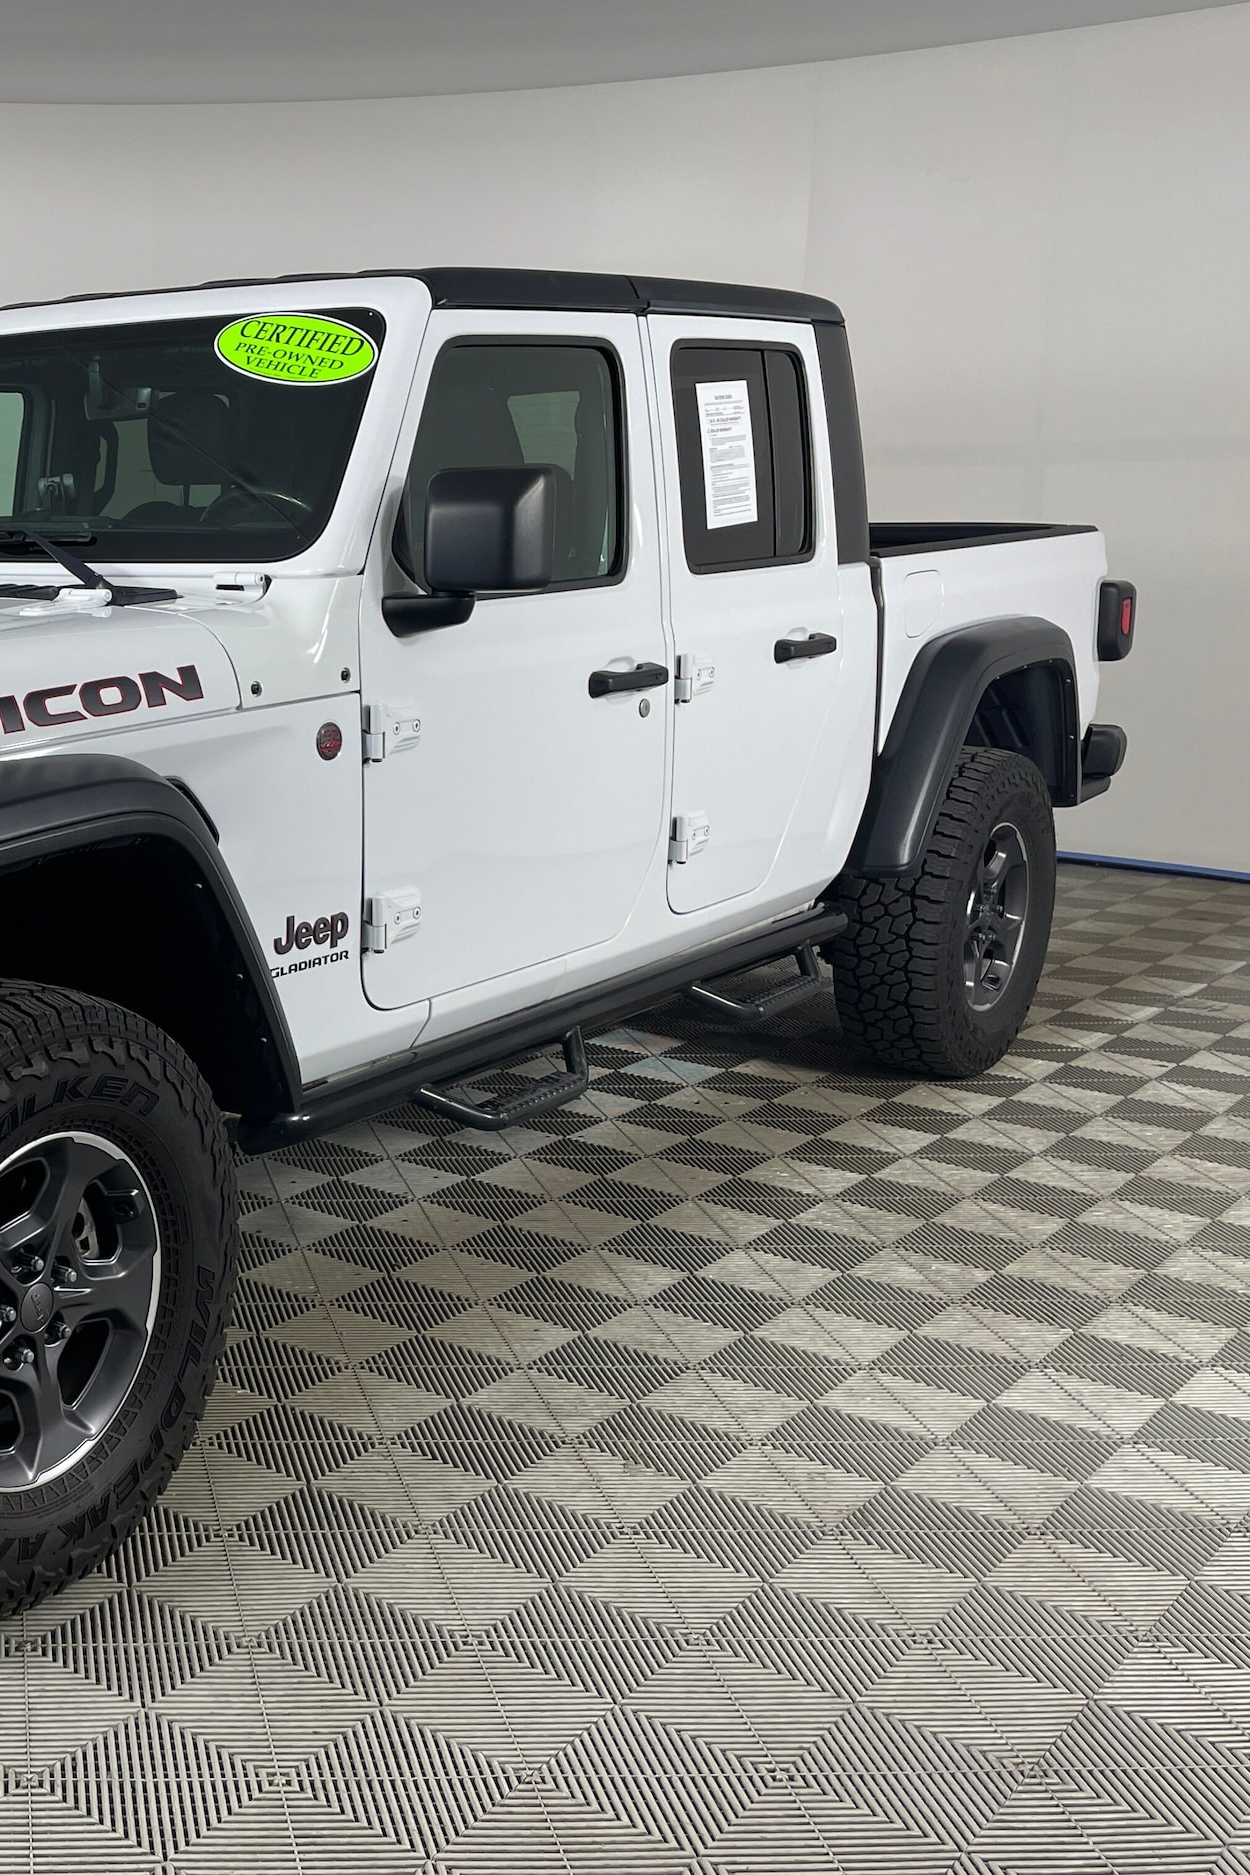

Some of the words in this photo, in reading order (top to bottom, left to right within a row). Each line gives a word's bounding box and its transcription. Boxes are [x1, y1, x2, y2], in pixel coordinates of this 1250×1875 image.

[240, 319, 365, 356] CERTIFIED
[234, 342, 344, 370] PRE-OWNED
[245, 356, 322, 378] VEHICLE
[273, 911, 349, 955] Jeep
[270, 950, 349, 979] GLADIATOR
[58, 1265, 216, 1545] WILDPEAK
